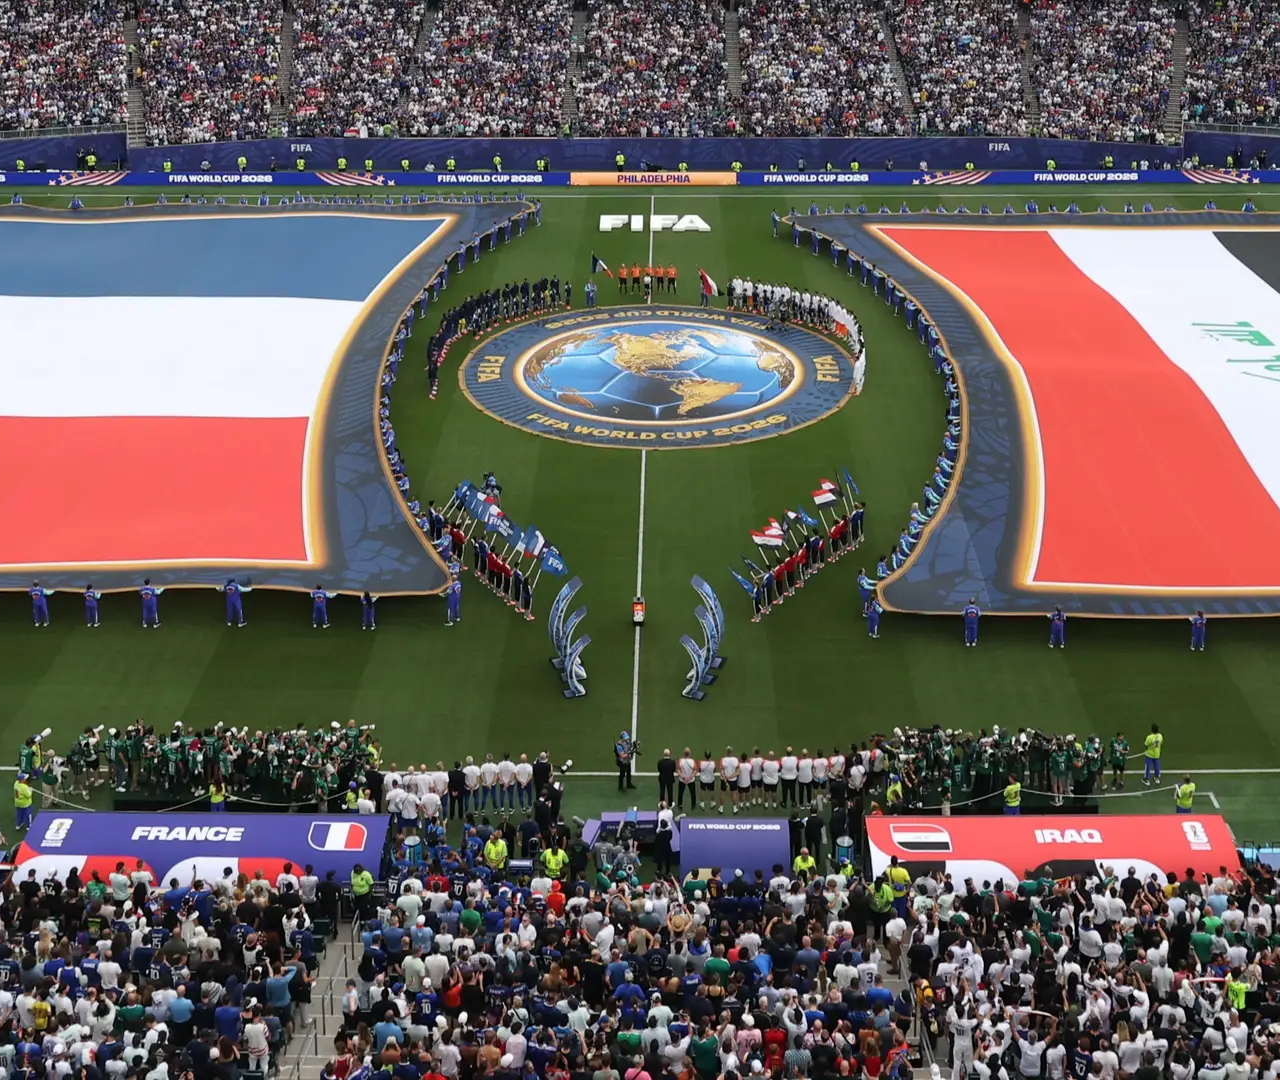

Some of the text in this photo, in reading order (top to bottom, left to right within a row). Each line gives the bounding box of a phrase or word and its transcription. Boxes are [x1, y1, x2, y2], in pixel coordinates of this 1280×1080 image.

[291, 144, 312, 153] FIFA
[989, 143, 1010, 152] FIFA
[168, 174, 273, 183] FIFA WORLD CUP 2026
[438, 174, 542, 183] FIFA WORLD CUP 2026
[617, 175, 690, 183] PHILADELPHIA
[764, 174, 869, 182] FIFA WORLD CUP 2026
[1034, 173, 1138, 182] FIFA WORLD CUP 2026
[599, 214, 711, 232] FIFA
[478, 355, 506, 383] FIFA
[812, 355, 840, 382] FIFA
[526, 413, 788, 440] FIFA WORLD CUP 2026
[131, 826, 245, 842] FRANCE
[1034, 829, 1103, 843] IRAQ
[388, 882, 398, 894] 10
[454, 884, 463, 896] 10
[150, 969, 159, 980] 10
[867, 972, 873, 983] 3
[421, 1002, 431, 1014] 10
